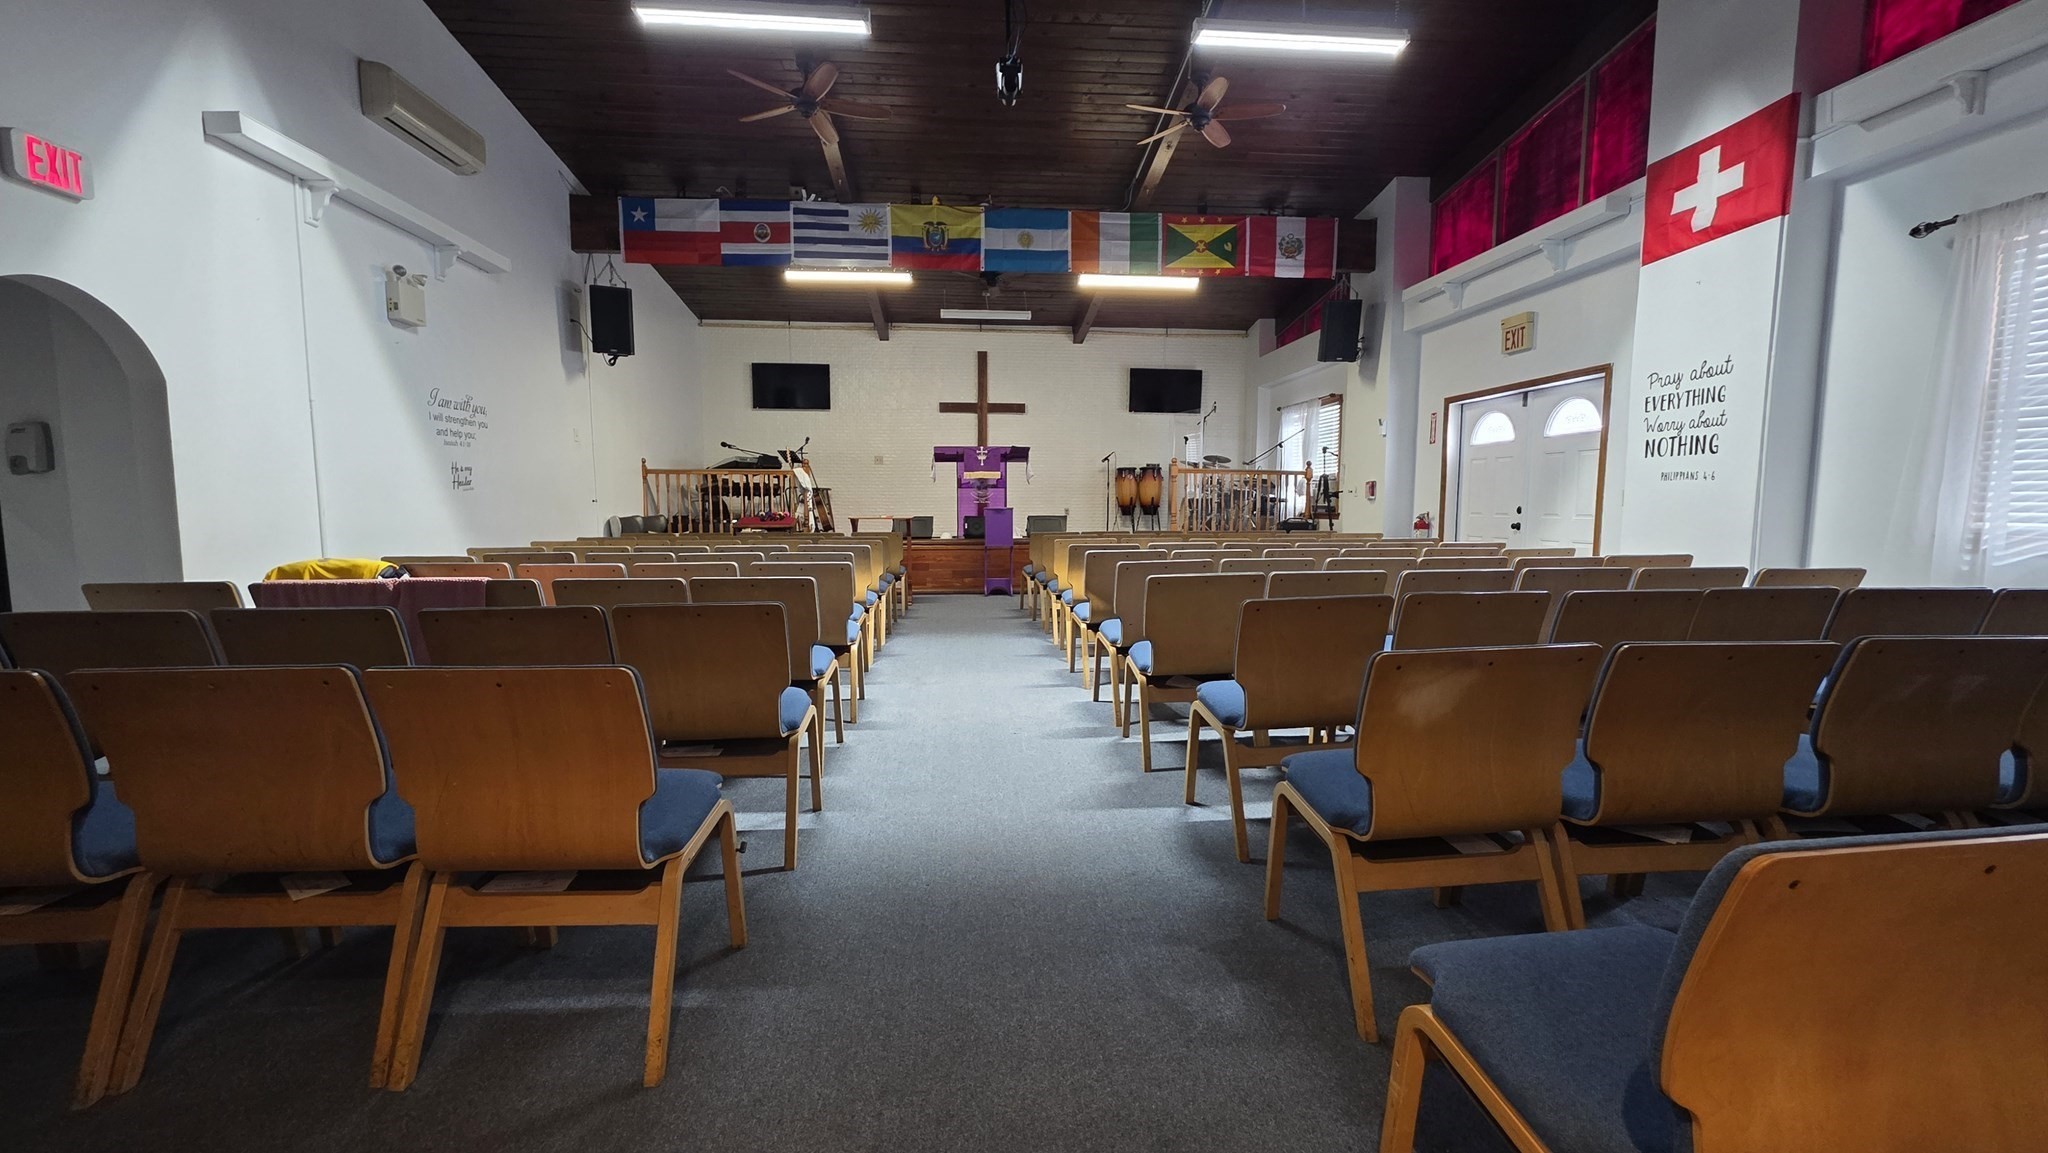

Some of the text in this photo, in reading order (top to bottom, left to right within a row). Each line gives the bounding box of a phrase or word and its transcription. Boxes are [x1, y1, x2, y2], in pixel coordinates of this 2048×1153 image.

[26, 134, 83, 195] EXIT
[1505, 326, 1525, 351] EXIT
[1647, 354, 1734, 390] Pray about
[427, 387, 440, 407] I
[438, 398, 452, 410] am
[453, 394, 473, 413] with
[1644, 384, 1727, 413] EVERYTHING
[432, 412, 444, 422] will
[445, 415, 476, 427] strengthen
[477, 420, 489, 430] you
[435, 428, 449, 437] and
[449, 428, 463, 440] help
[1643, 409, 1728, 436] Worry about
[1644, 433, 1720, 459] NOTHING
[1660, 470, 1699, 481] PHILIPPIANS
